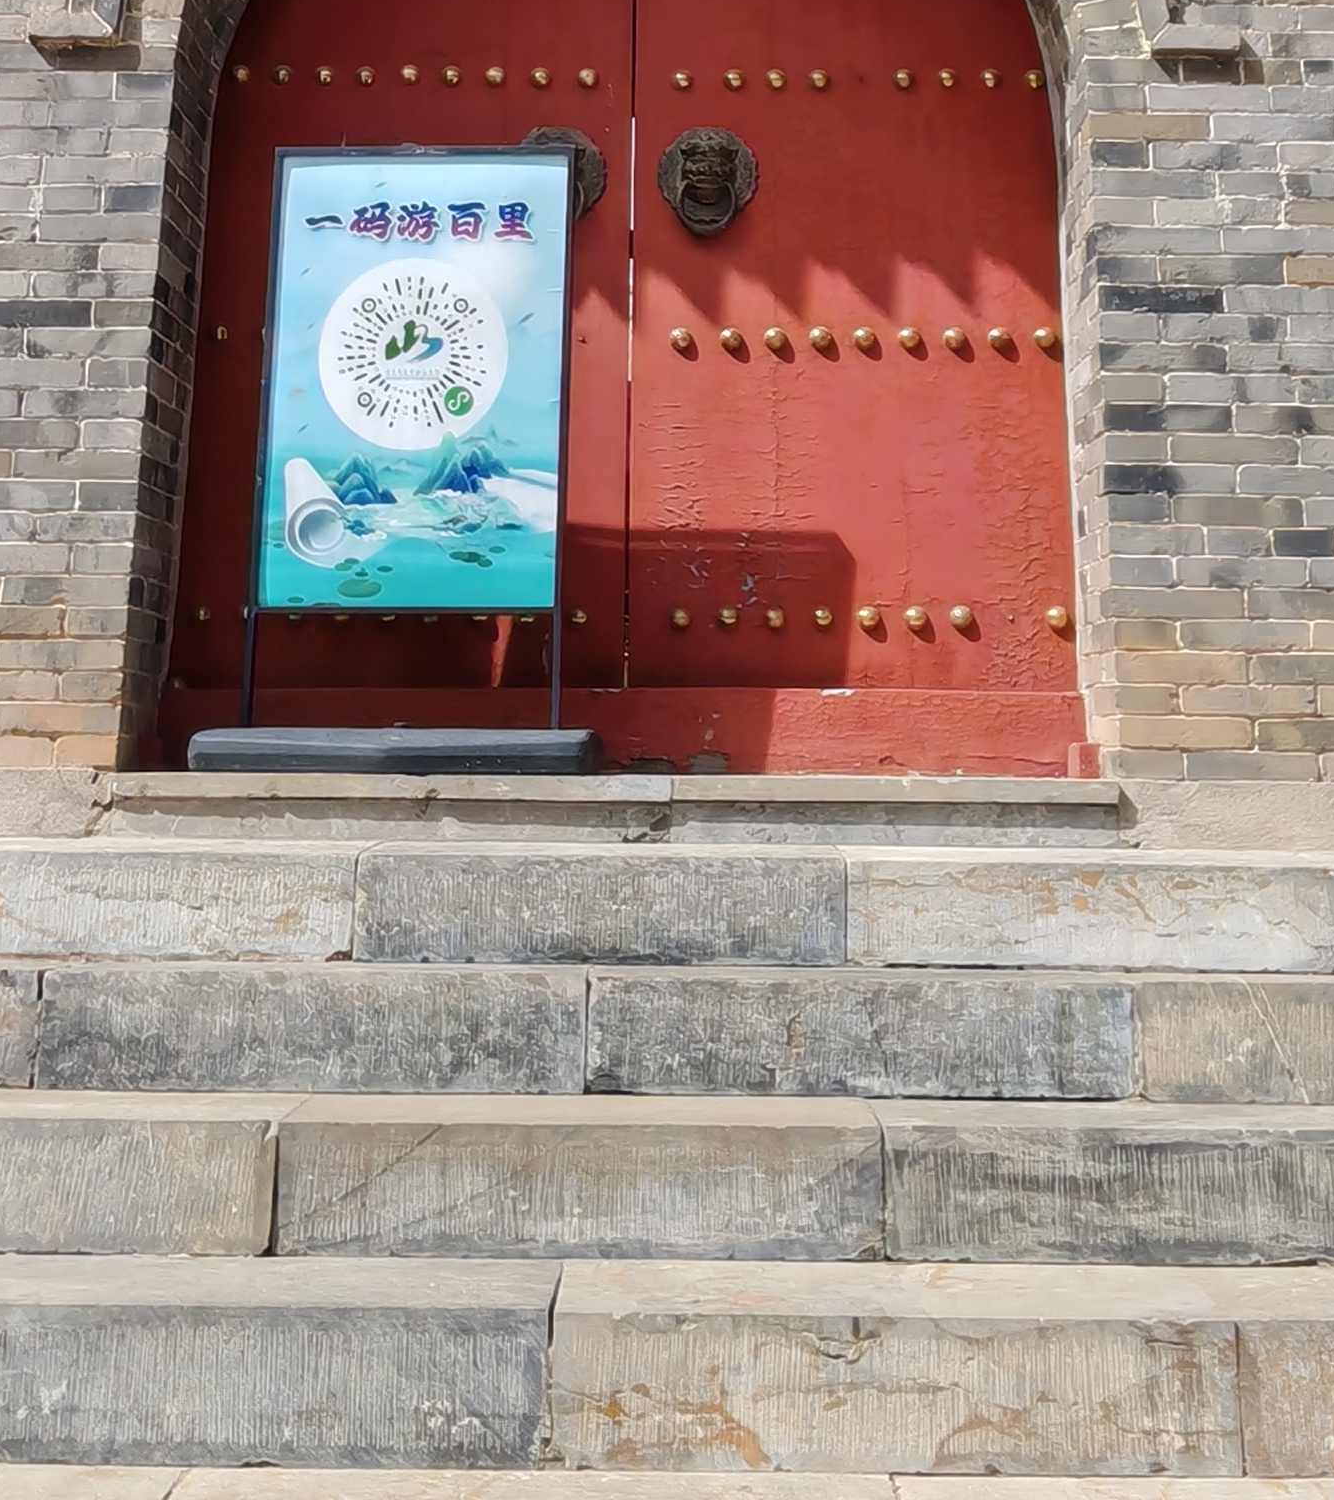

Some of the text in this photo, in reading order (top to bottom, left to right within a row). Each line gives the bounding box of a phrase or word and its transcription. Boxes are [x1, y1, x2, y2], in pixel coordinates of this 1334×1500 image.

[304, 200, 534, 243] 一码游百里
